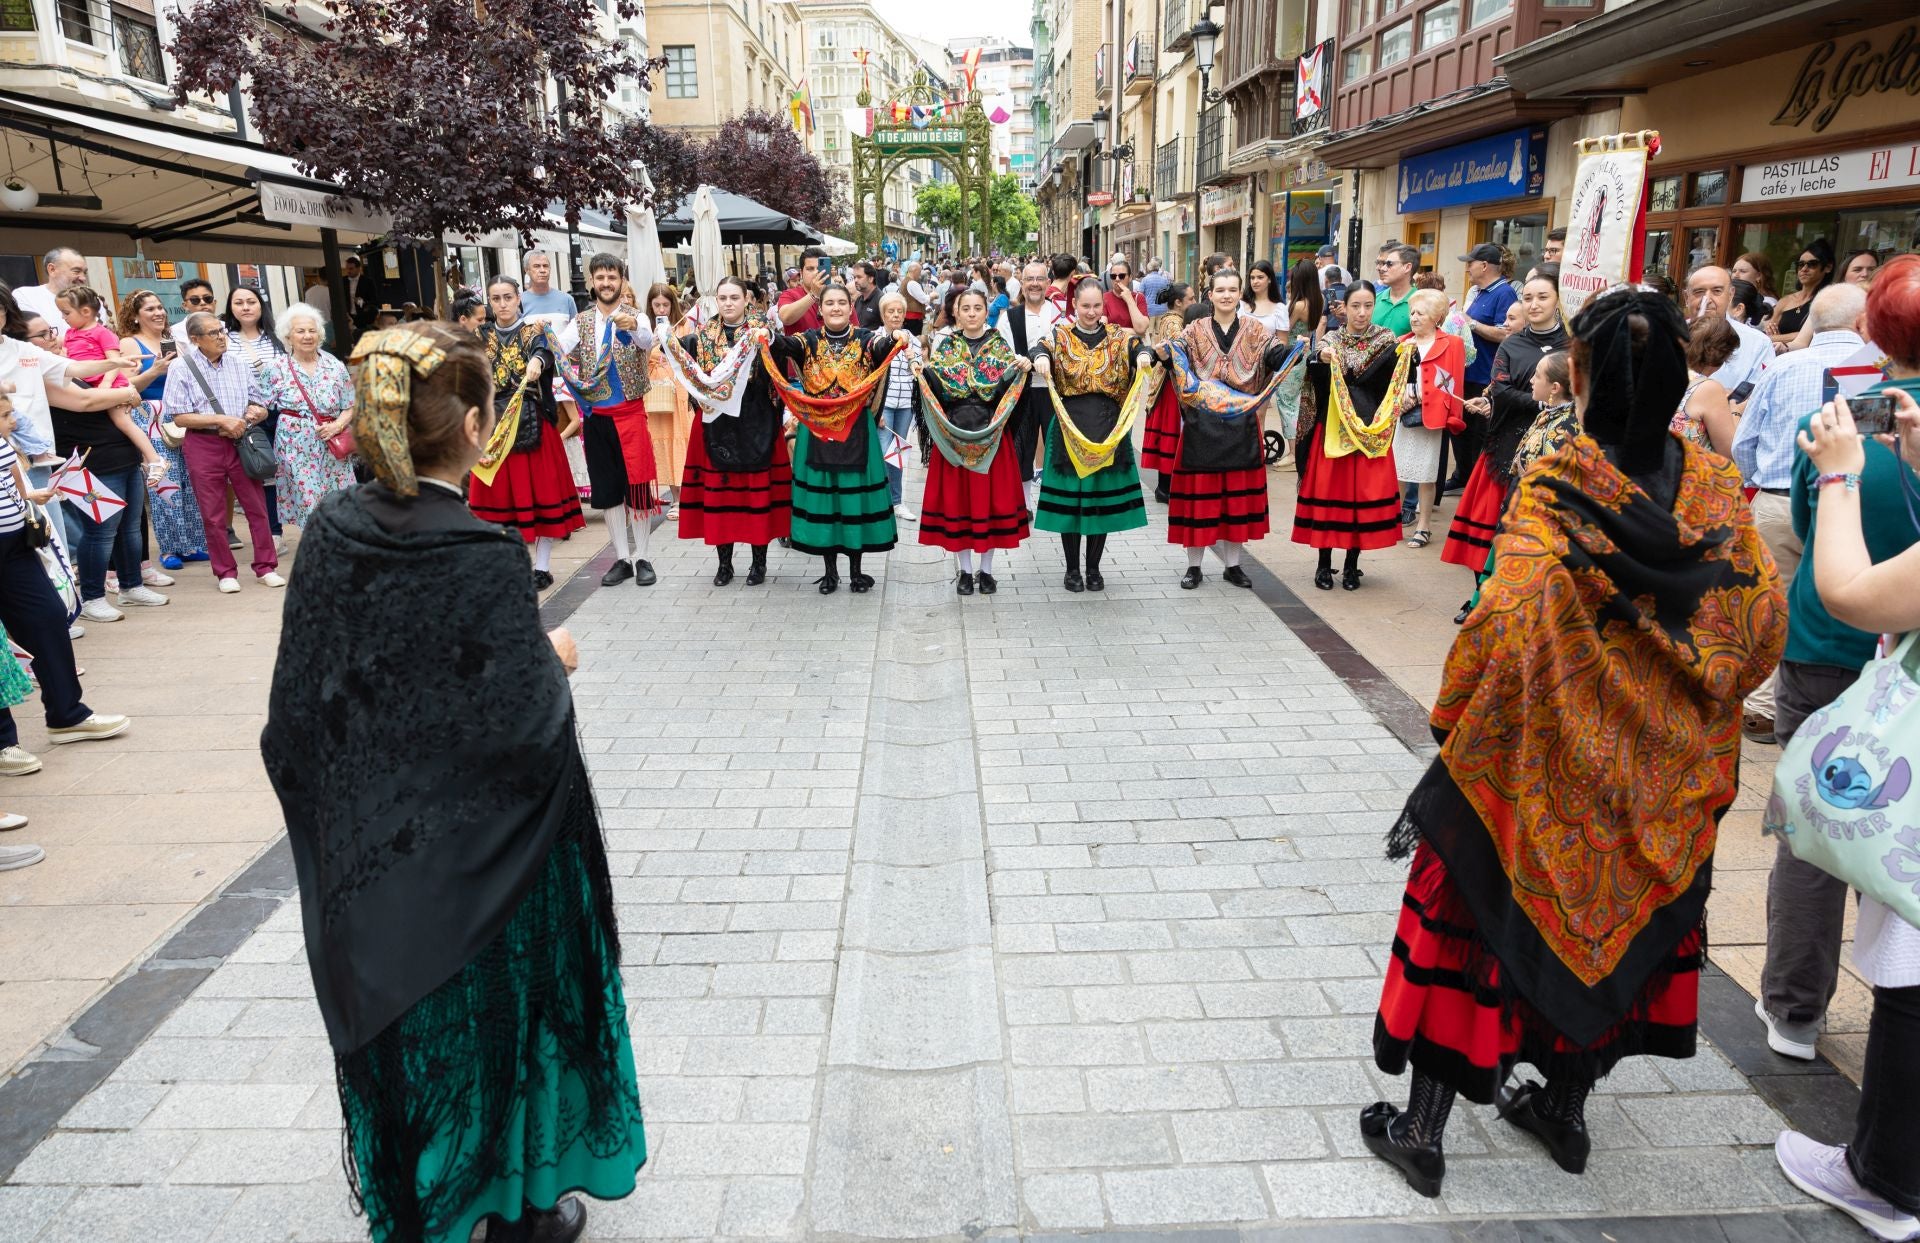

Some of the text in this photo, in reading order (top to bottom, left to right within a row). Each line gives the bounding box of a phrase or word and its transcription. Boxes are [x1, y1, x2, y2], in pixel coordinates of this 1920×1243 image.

[1769, 40, 1836, 127] La
[877, 131, 963, 143] 11 DE JUNIO DE 1521
[1410, 172, 1423, 194] La
[1425, 169, 1447, 192] Casa
[1448, 161, 1465, 188] del
[1465, 153, 1508, 185] Bacalao
[1763, 156, 1840, 179] PASTILLAS
[1868, 150, 1891, 181] El
[1573, 172, 1596, 220] GRUPO
[1760, 176, 1836, 196] café y leche
[273, 196, 297, 214] FOOD
[299, 201, 307, 215] &
[1794, 772, 1892, 841] WHATEVER
